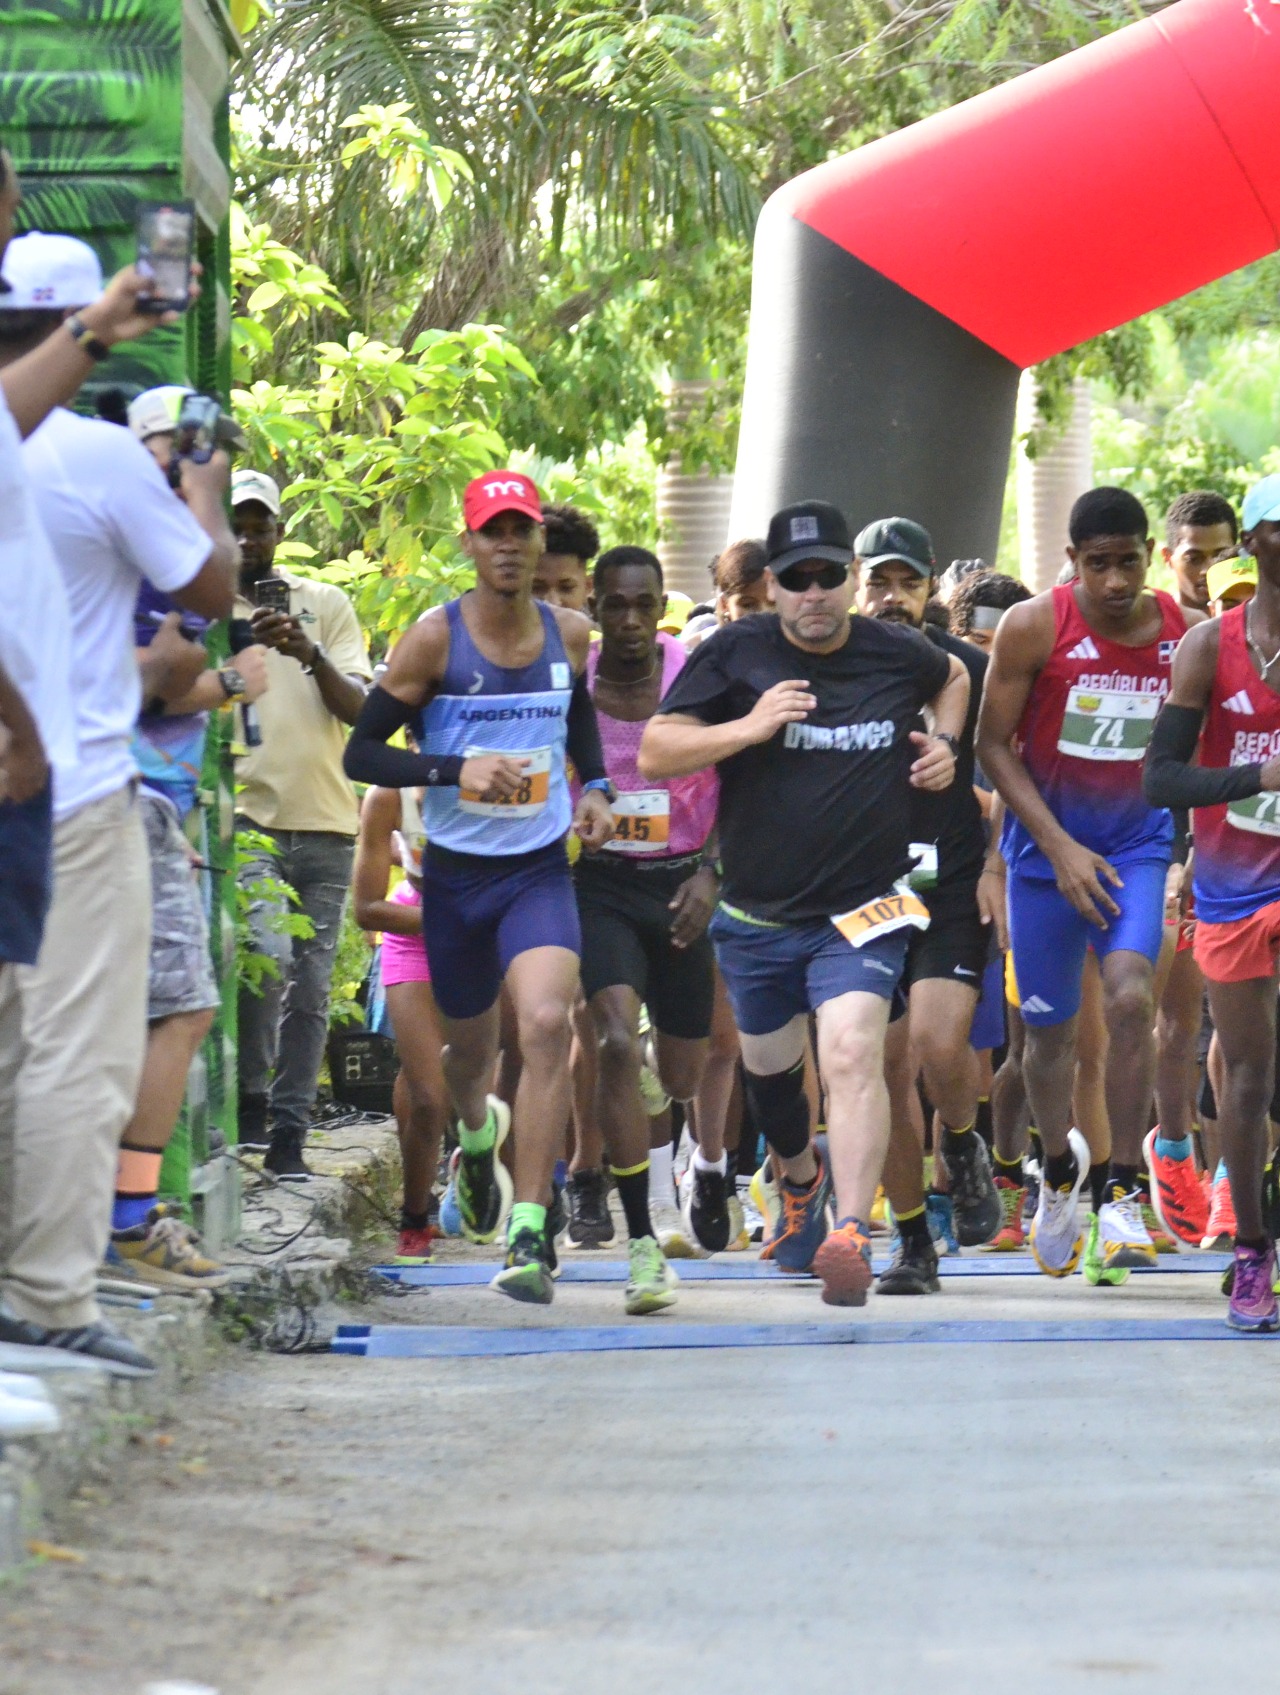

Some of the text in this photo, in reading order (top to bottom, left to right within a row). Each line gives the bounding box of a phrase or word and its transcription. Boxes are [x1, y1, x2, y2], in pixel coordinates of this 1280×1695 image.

[483, 480, 526, 498] TYR
[1089, 717, 1126, 747] 74
[858, 896, 906, 928] 107
